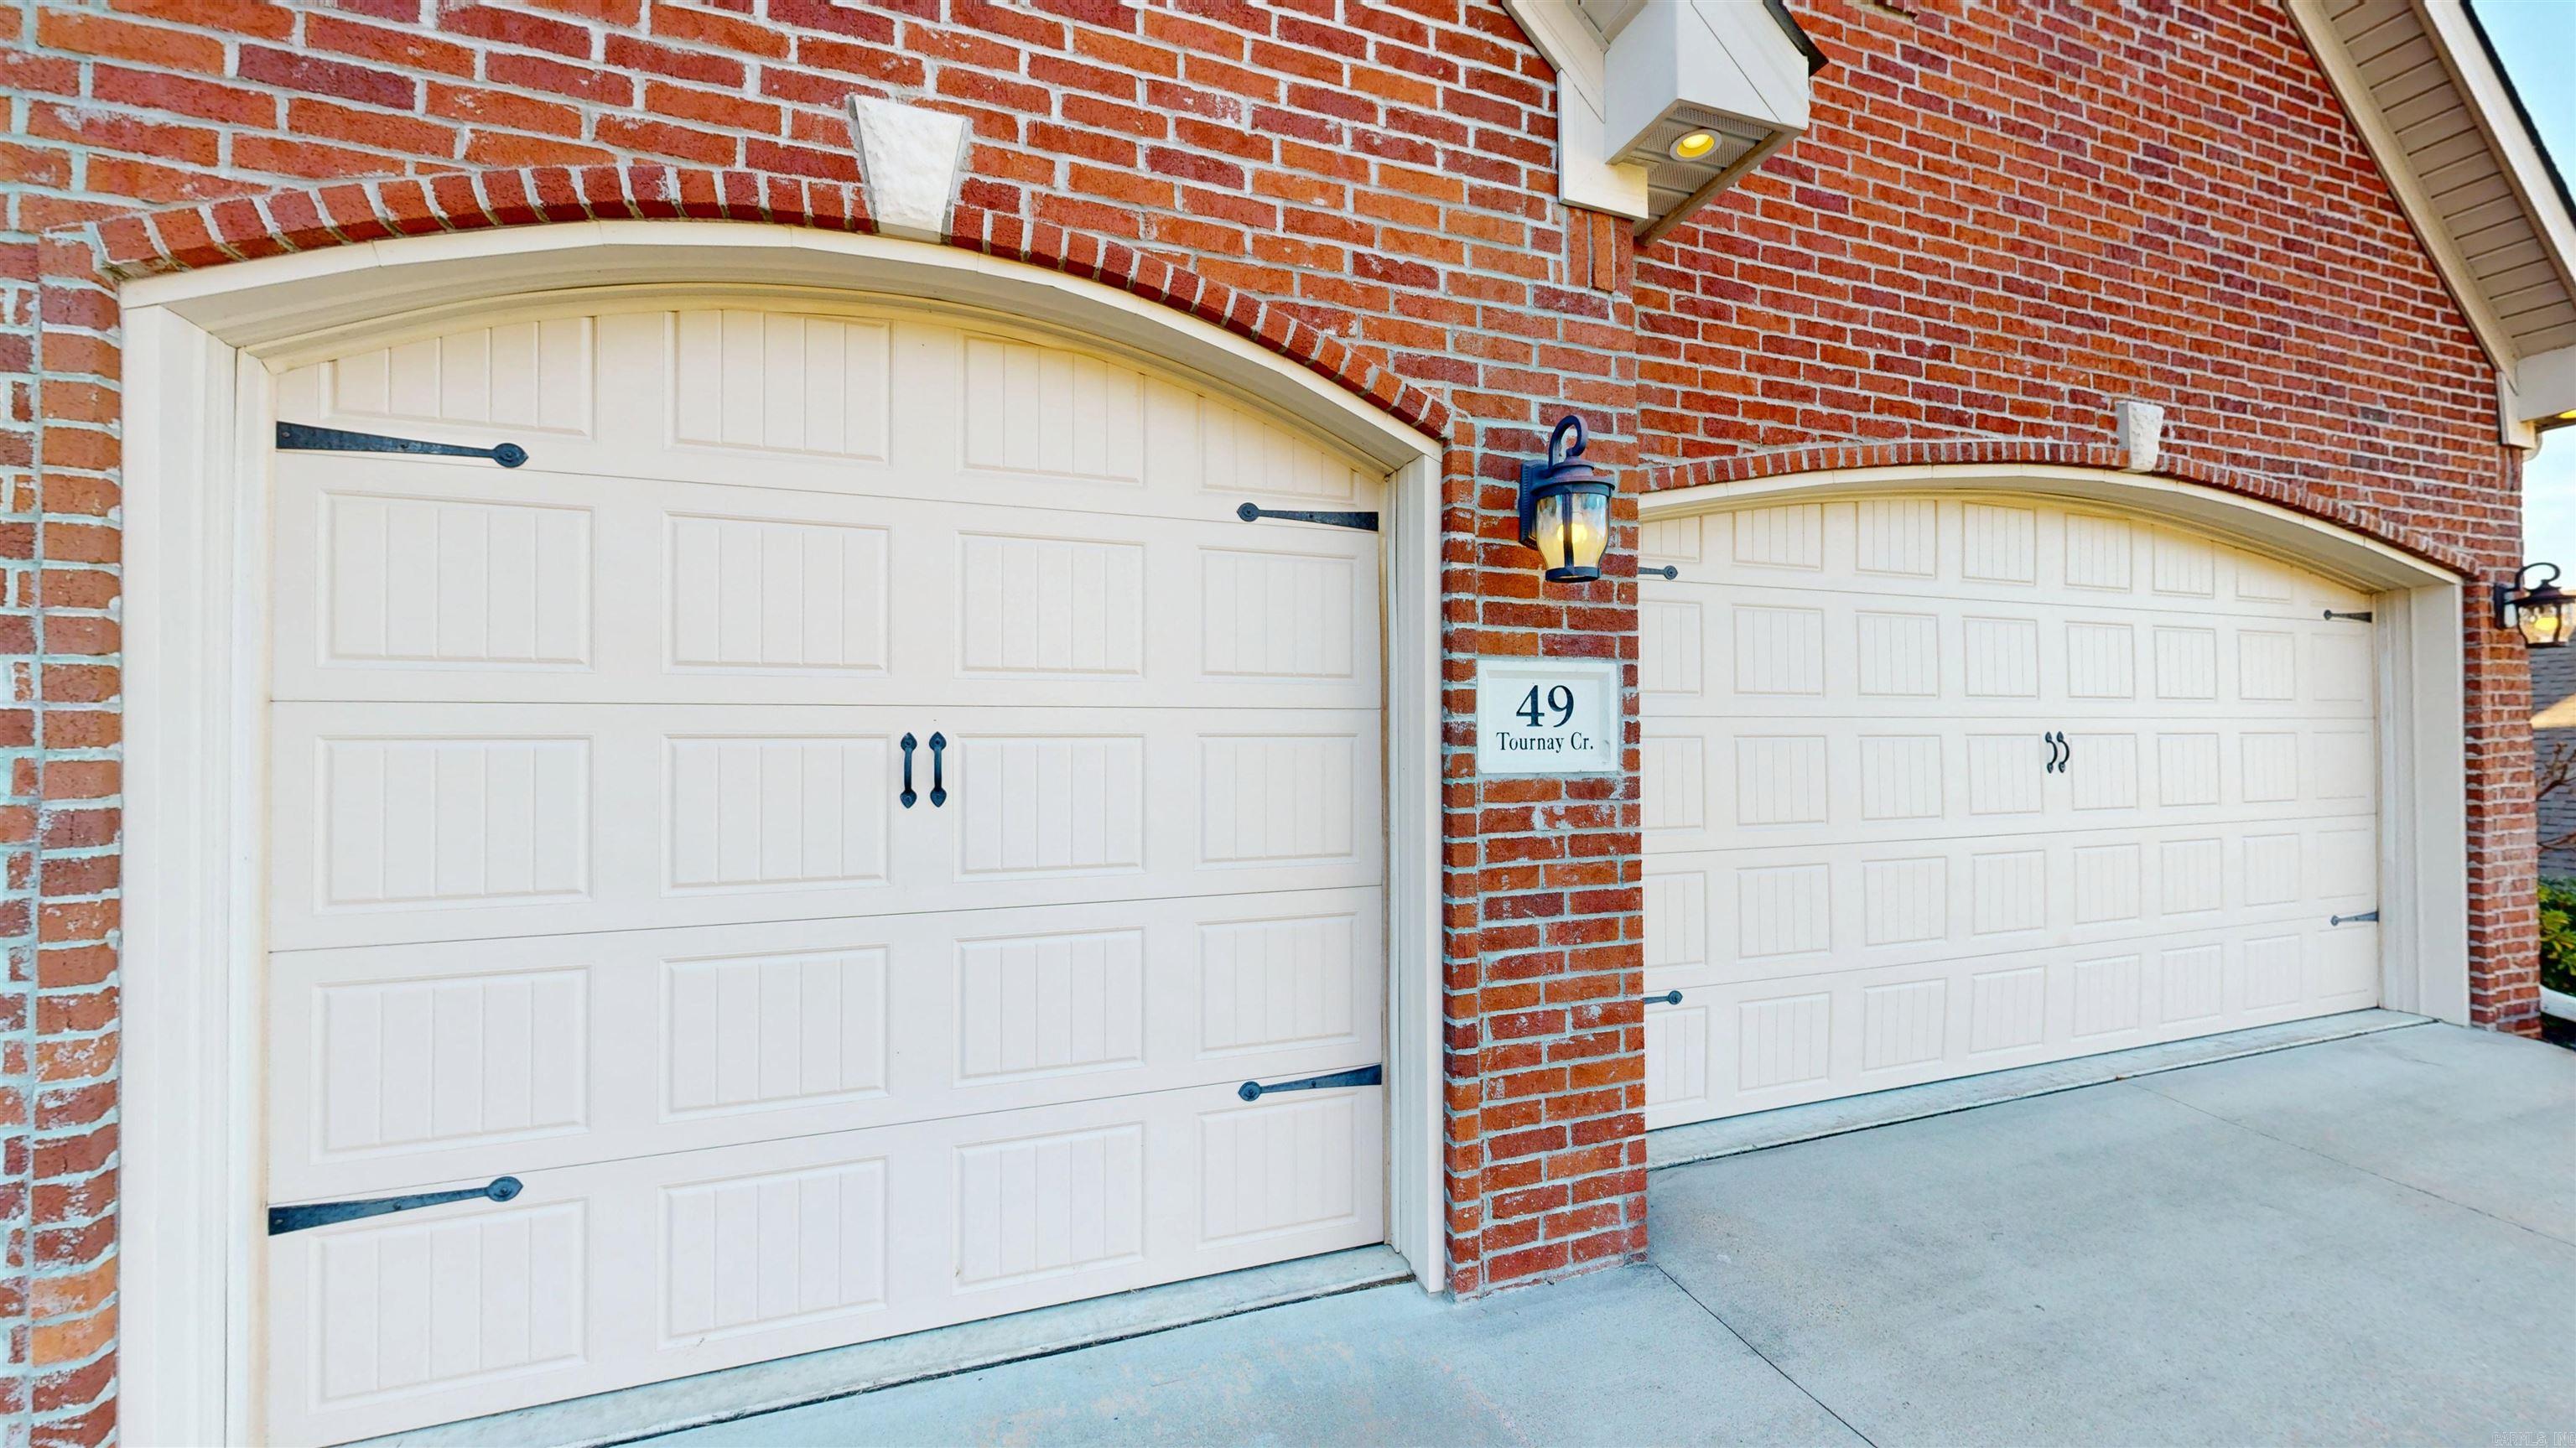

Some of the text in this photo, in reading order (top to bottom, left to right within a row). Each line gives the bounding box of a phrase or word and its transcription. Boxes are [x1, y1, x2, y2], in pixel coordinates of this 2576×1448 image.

[1516, 684, 1575, 728] 49
[1496, 731, 1594, 754] Tournay Cr.
